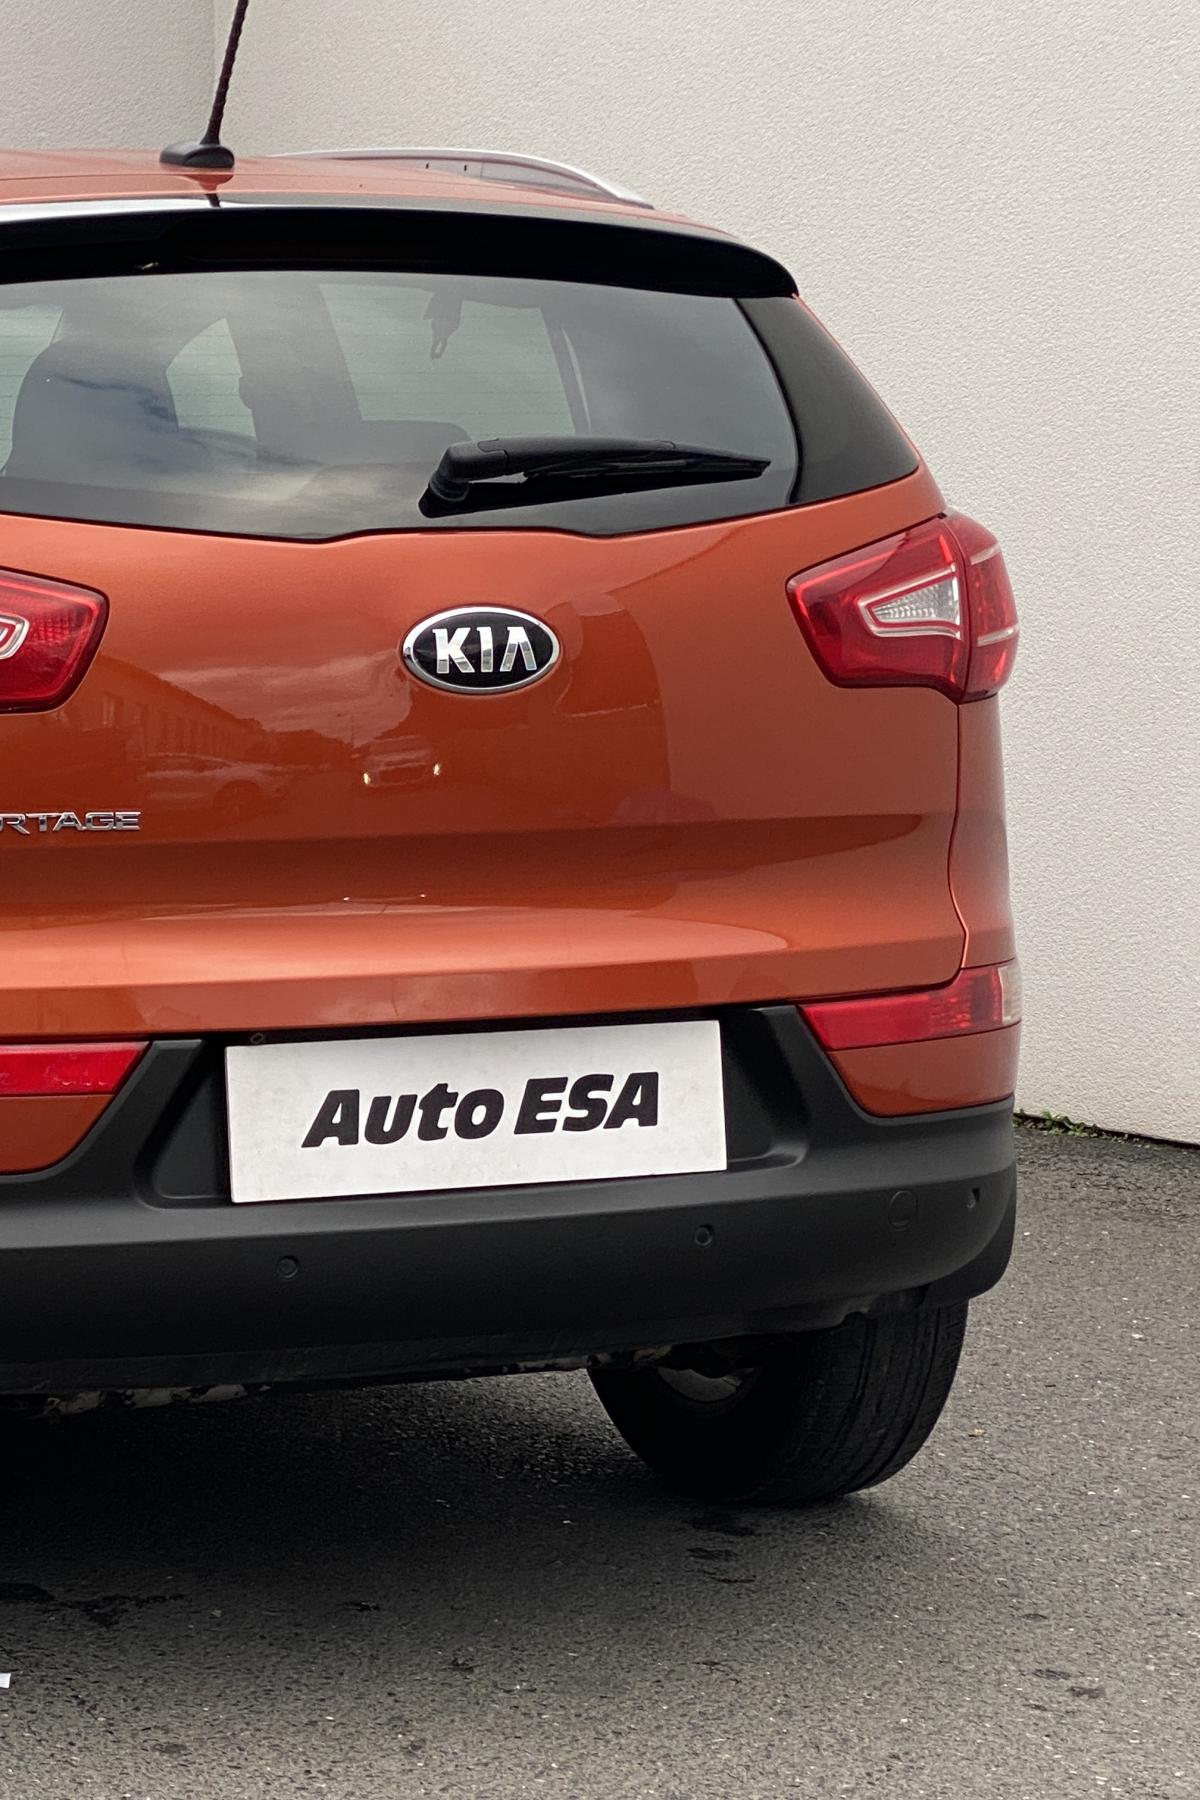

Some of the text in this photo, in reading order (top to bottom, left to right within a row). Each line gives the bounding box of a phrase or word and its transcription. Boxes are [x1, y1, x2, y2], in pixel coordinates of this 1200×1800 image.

[432, 626, 538, 674] KIA
[301, 1072, 659, 1148] Auto ESA
